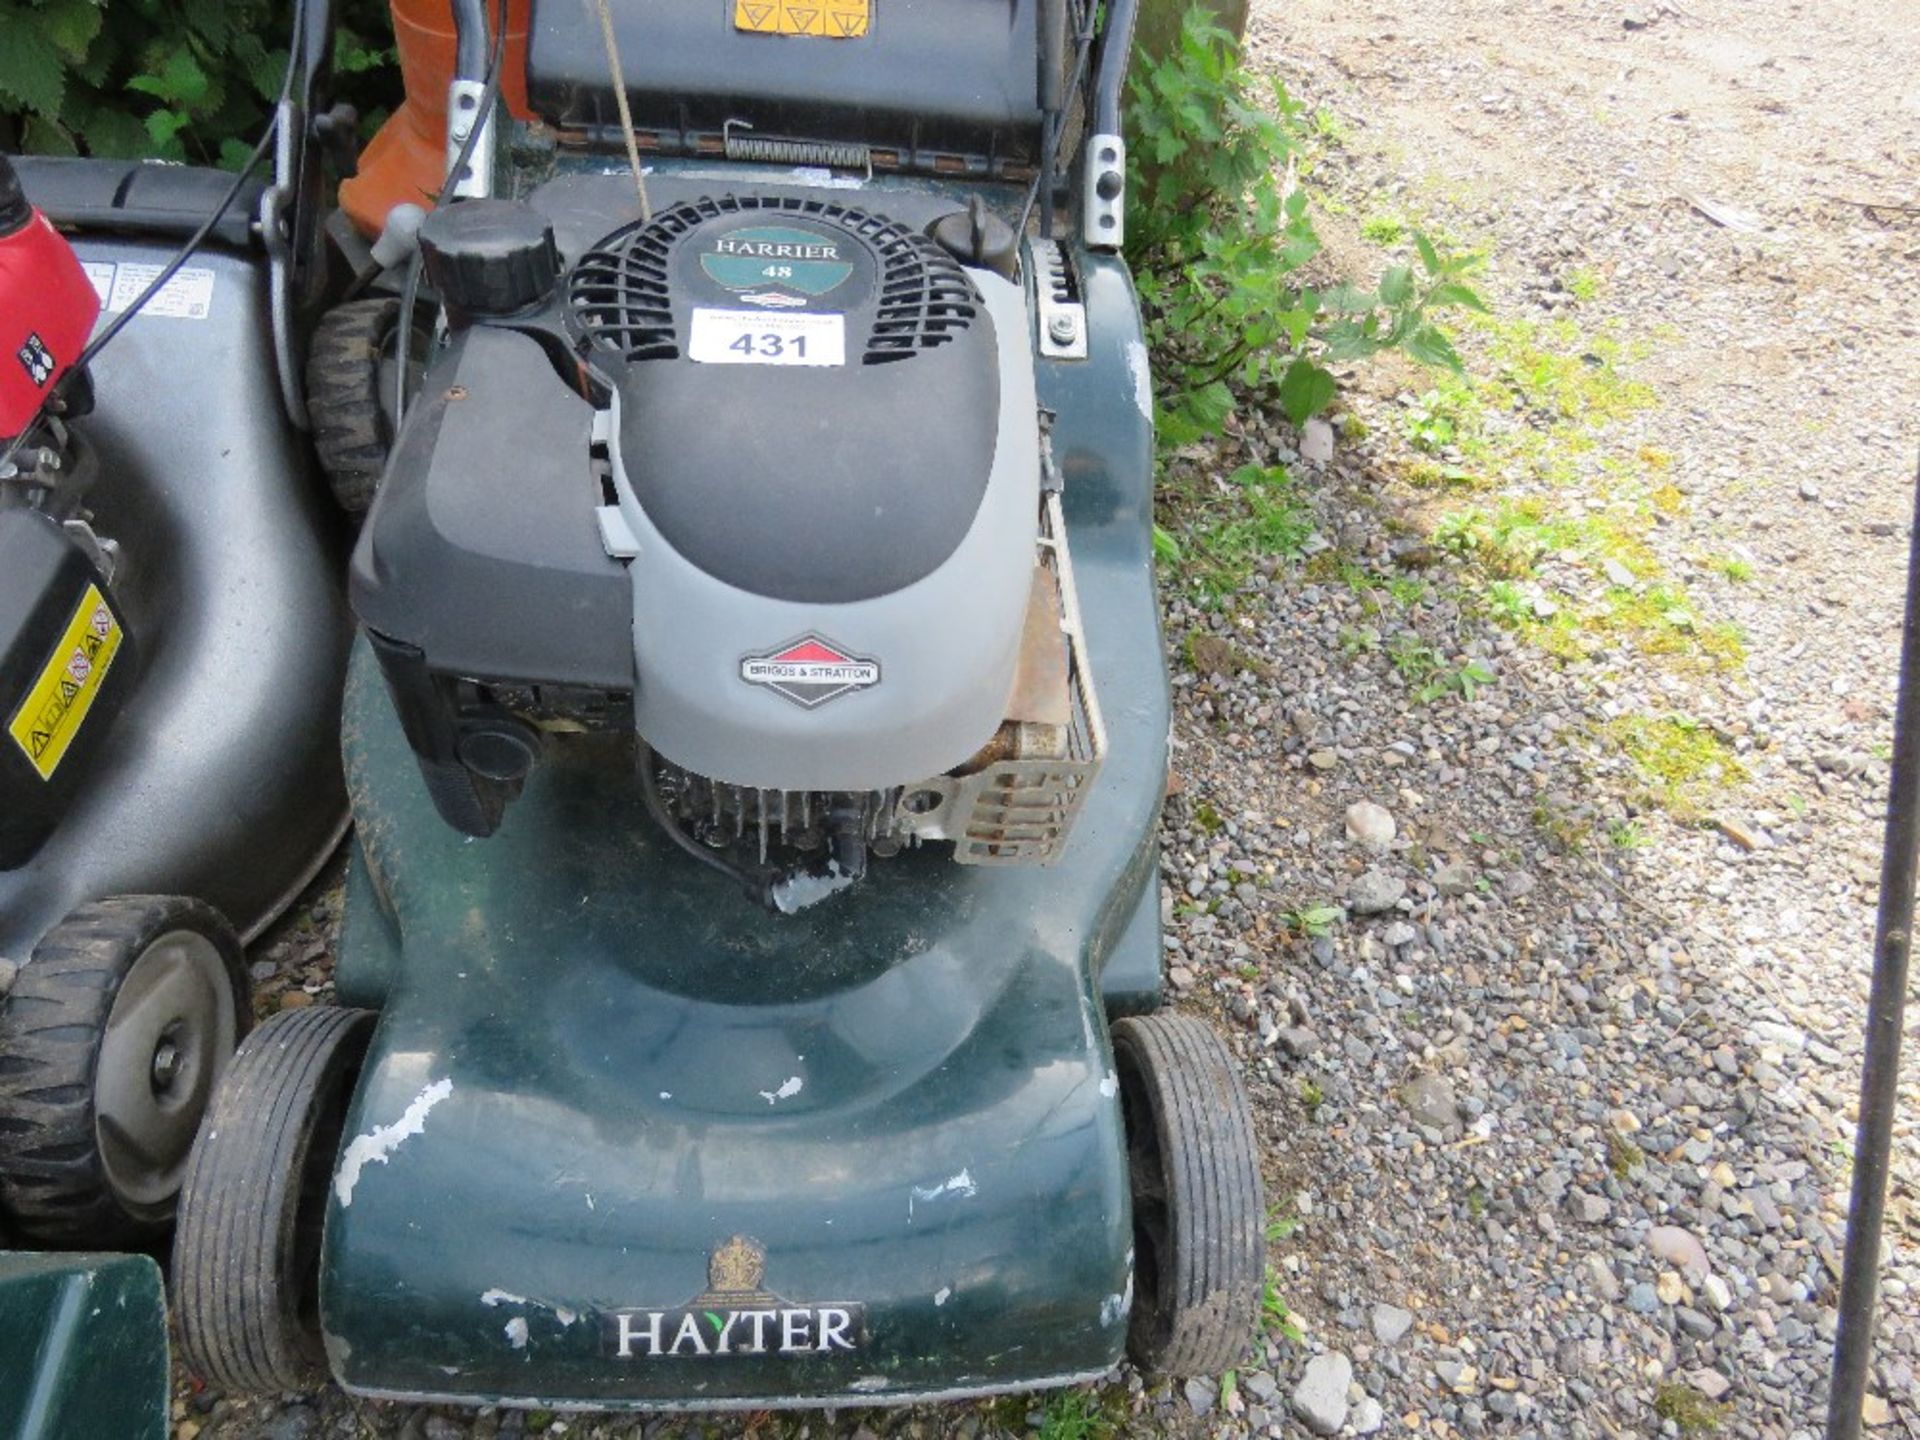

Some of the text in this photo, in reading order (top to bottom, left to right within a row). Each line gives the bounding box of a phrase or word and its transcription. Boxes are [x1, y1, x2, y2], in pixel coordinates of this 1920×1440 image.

[716, 239, 840, 260] HARRIER
[762, 265, 793, 278] 48
[729, 332, 807, 358] 431
[750, 664, 872, 679] BRIGGS & STRATTON
[616, 1308, 857, 1357] HAYTER
